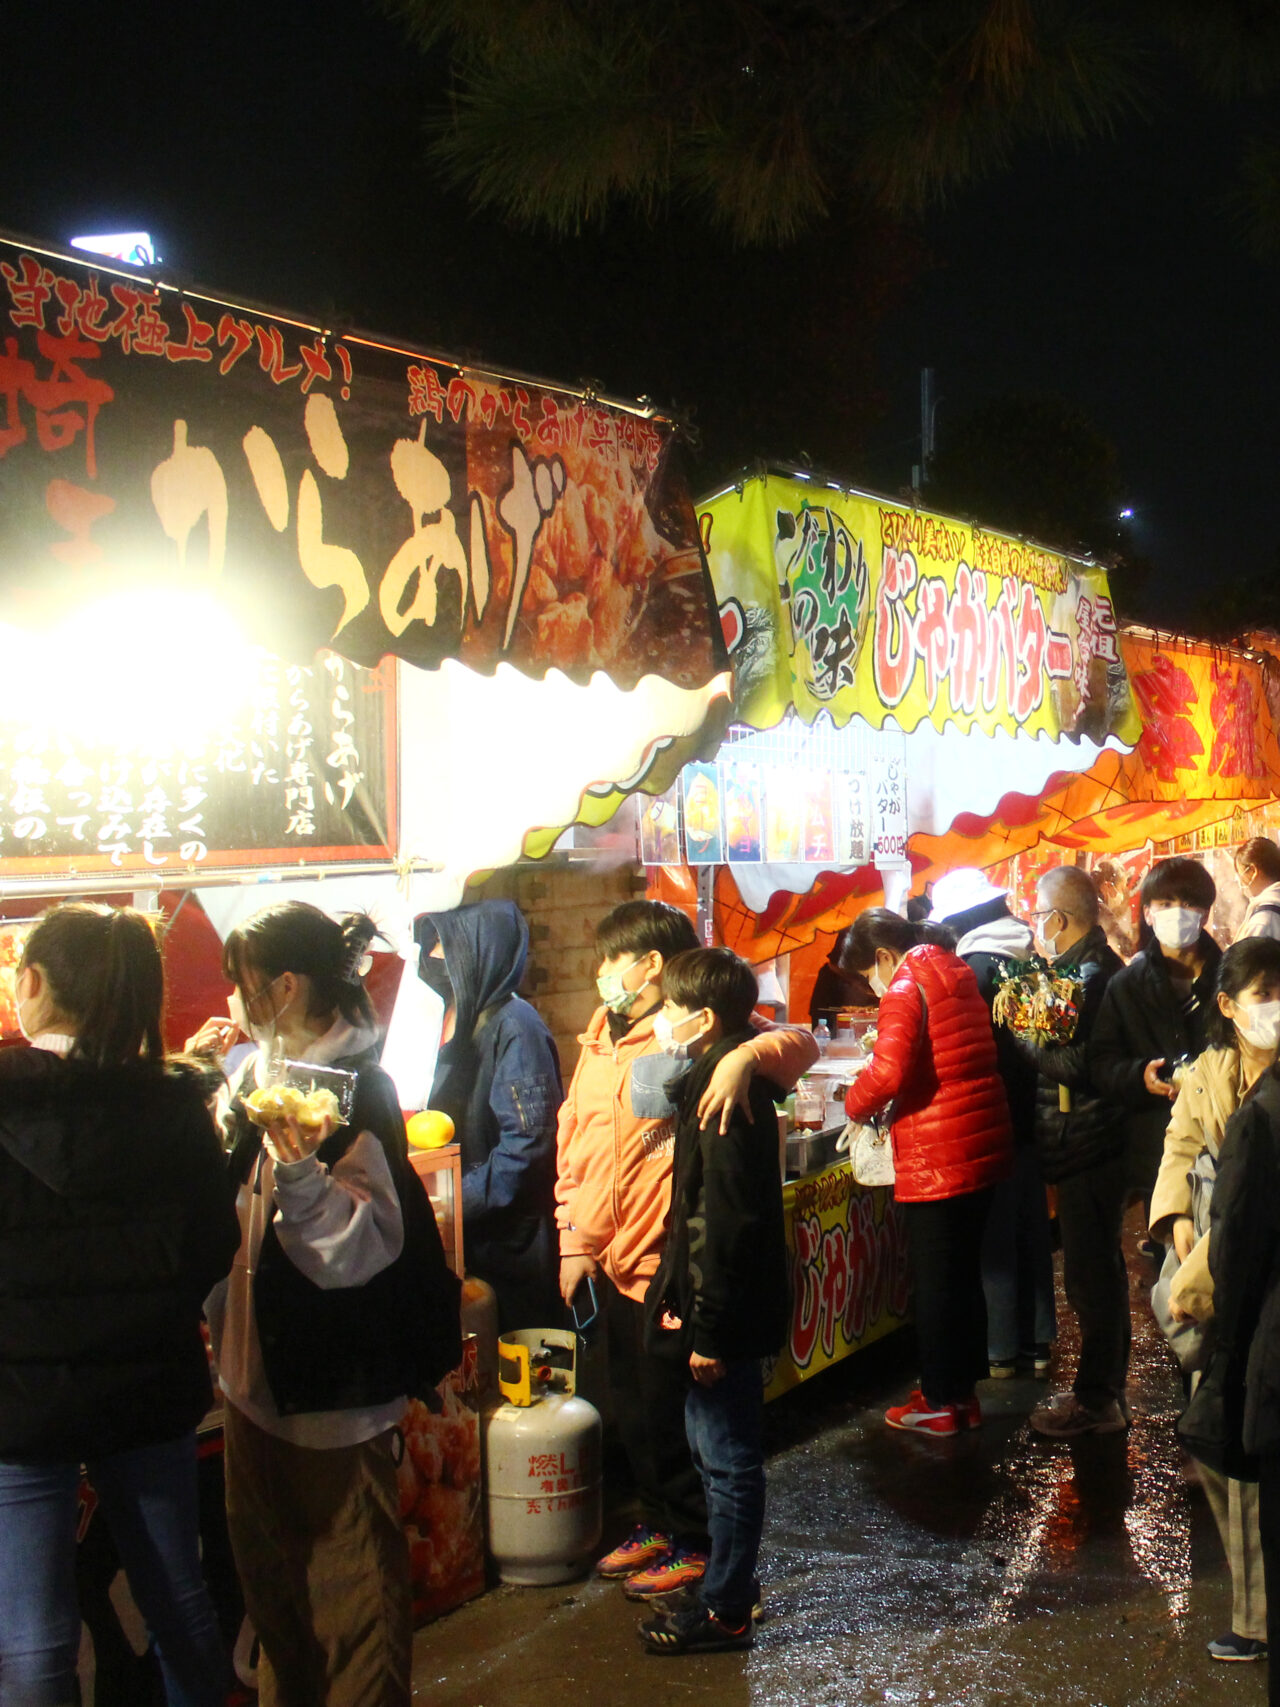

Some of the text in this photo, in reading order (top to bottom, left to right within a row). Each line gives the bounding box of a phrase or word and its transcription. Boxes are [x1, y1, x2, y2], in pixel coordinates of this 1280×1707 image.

[150, 393, 563, 650] からあげ
[873, 546, 1073, 722] じゃがバター
[283, 664, 316, 836] からあげ専門店
[848, 778, 865, 860] つけ放題
